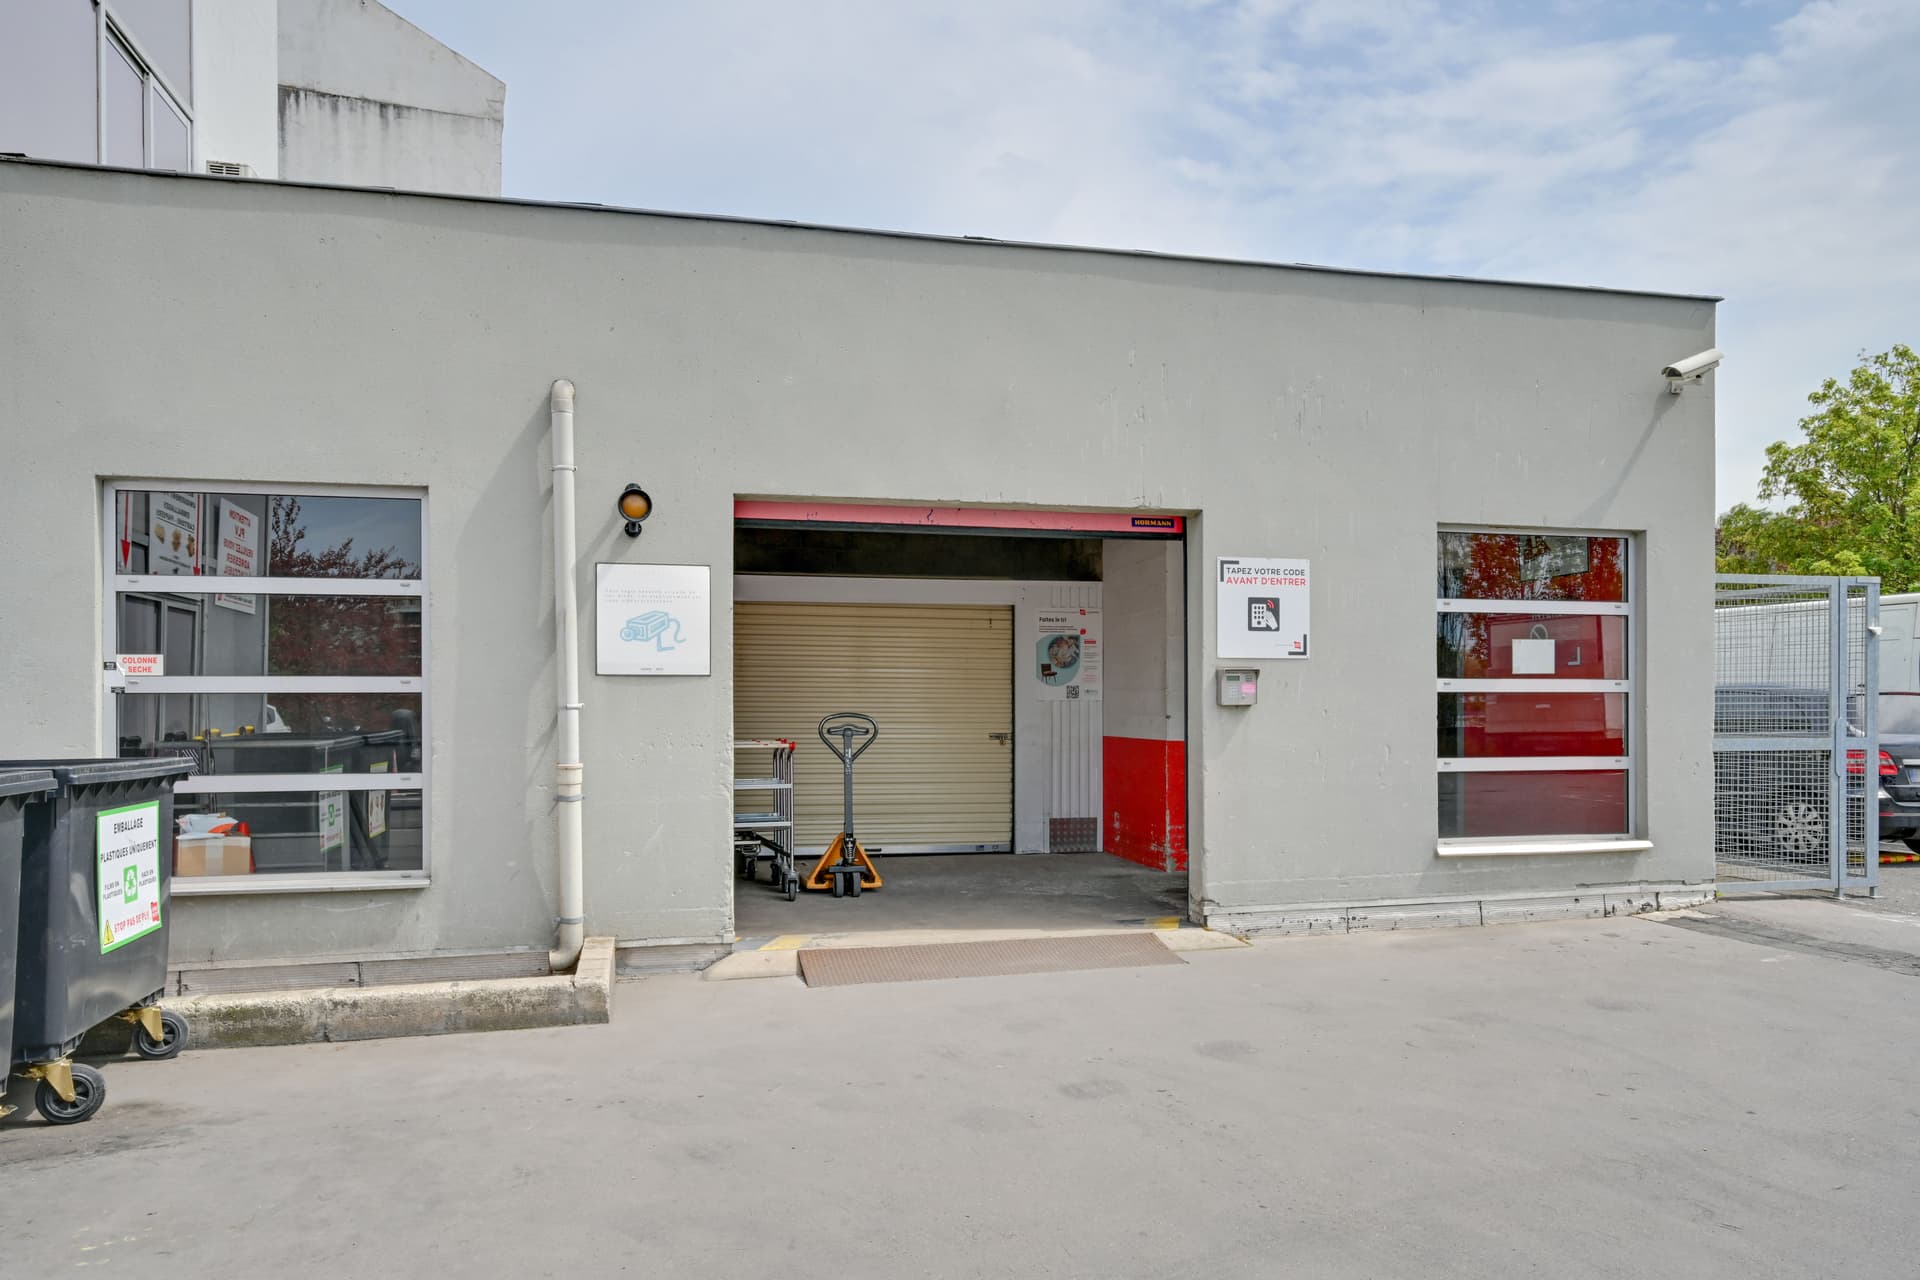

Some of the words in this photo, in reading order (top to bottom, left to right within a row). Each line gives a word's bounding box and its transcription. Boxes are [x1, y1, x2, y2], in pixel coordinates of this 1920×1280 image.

[1226, 567, 1252, 575] TAPEZ
[1254, 568, 1281, 576] VOTRE
[1226, 577, 1259, 585] AVANT
[1261, 578, 1306, 586] D'ENTRER
[113, 818, 143, 834] EMBALLAGE
[100, 847, 128, 863] PLASTIQUES
[129, 840, 157, 855] UNIQUEMENT
[114, 920, 126, 933] STOP
[127, 916, 136, 927] PAS
